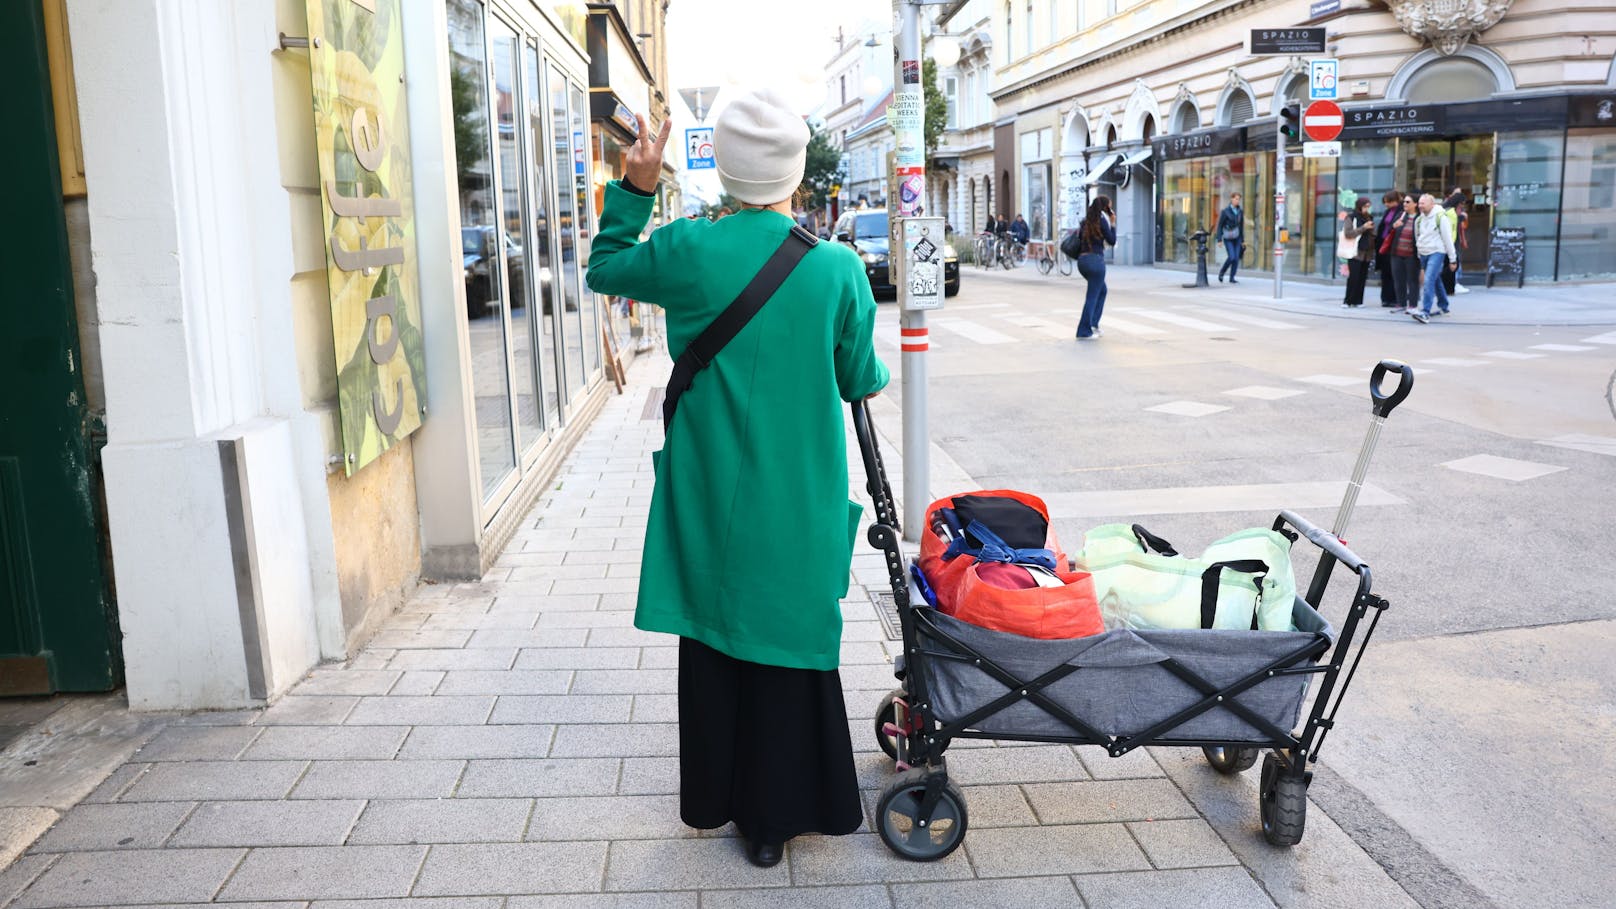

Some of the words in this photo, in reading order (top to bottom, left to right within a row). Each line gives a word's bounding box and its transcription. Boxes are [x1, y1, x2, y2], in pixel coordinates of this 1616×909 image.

[1262, 31, 1309, 40] SPAZIO
[1315, 89, 1332, 97] Zone
[1354, 109, 1417, 122] SPAZIO
[1174, 134, 1211, 151] SPAZIO
[692, 160, 711, 168] Zone
